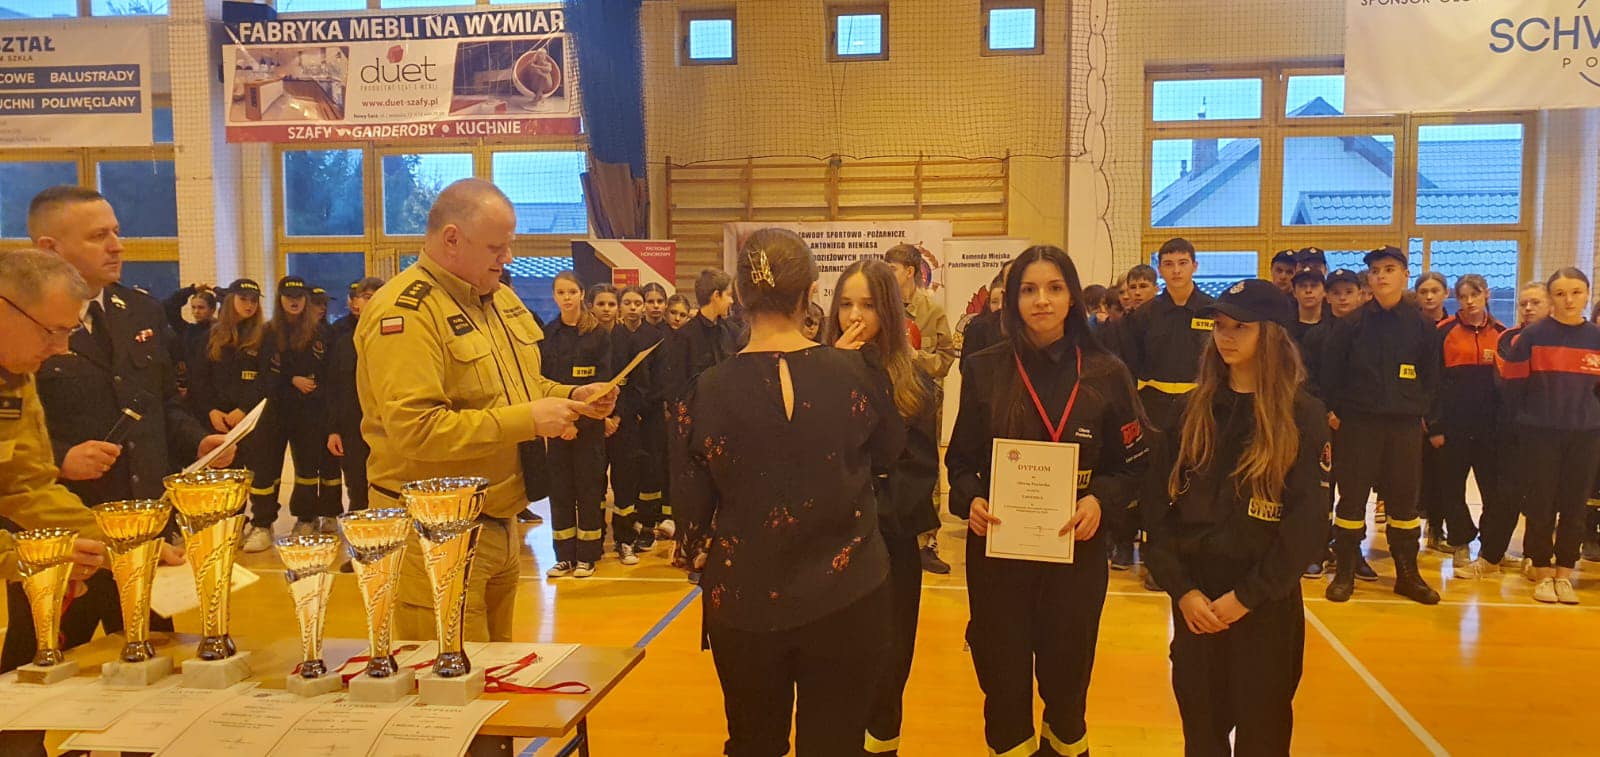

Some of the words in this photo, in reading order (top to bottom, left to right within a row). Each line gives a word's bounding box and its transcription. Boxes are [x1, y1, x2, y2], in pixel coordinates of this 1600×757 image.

[239, 20, 344, 42] FABRYKA
[351, 15, 419, 40] MEBLI
[424, 15, 459, 37] NA
[464, 10, 565, 35] WYMIAR
[0, 36, 55, 52] ZTAŁ
[360, 56, 437, 83] duet
[50, 70, 135, 83] BALUSTRADY
[42, 96, 136, 110] POLIWĘGLANY
[361, 97, 439, 108] www.duet-szafy.pl
[287, 126, 332, 140] SZAFY
[352, 122, 437, 138] GARDEROBY
[455, 120, 521, 136] KUCHNIE
[826, 231, 862, 239] SPORTOWO
[867, 229, 905, 238] POŻARNICZE
[810, 241, 845, 249] ANTONIEGO
[1017, 463, 1051, 472] DYPLOM
